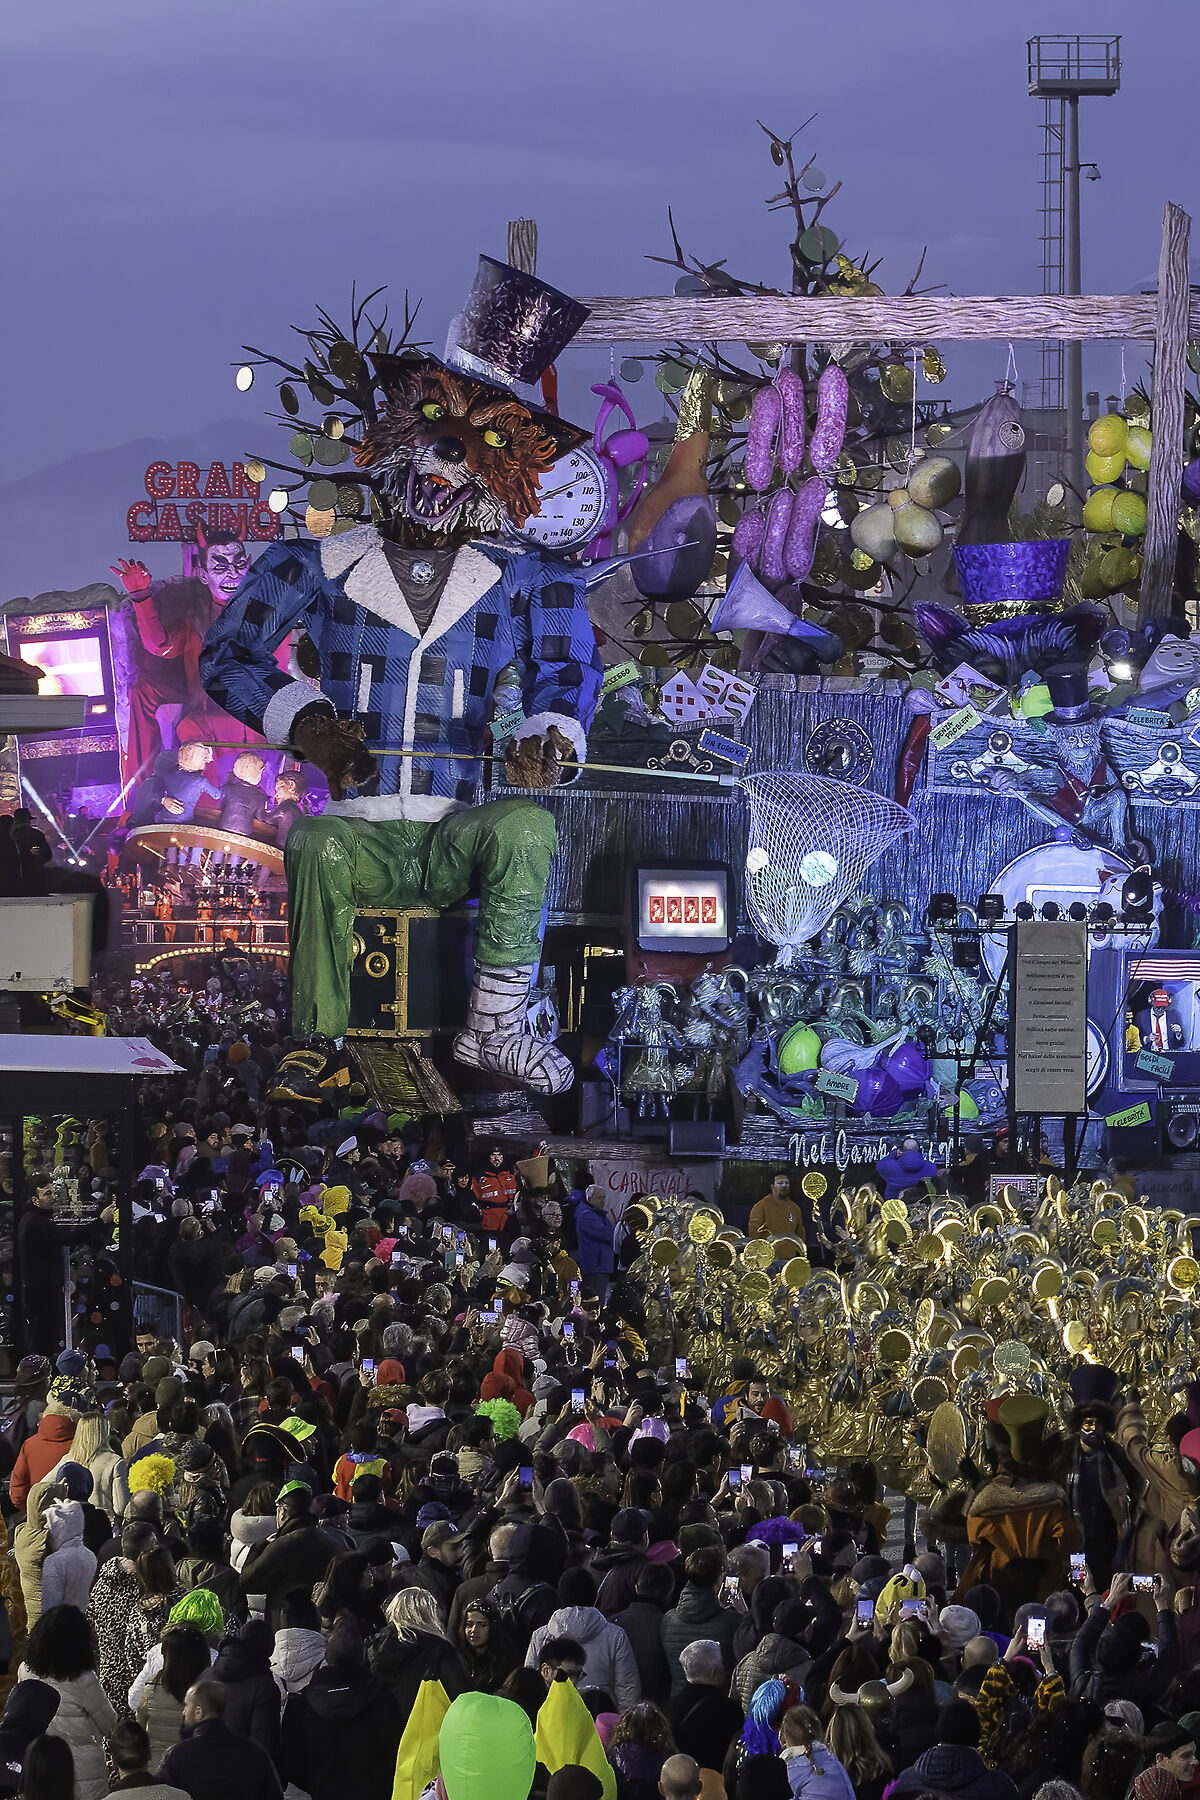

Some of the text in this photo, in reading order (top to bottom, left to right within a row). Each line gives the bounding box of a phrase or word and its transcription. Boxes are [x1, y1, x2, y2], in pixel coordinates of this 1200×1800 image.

[144, 460, 261, 499] GRAN
[126, 500, 281, 541] CASINO
[788, 1132, 826, 1168] Nel
